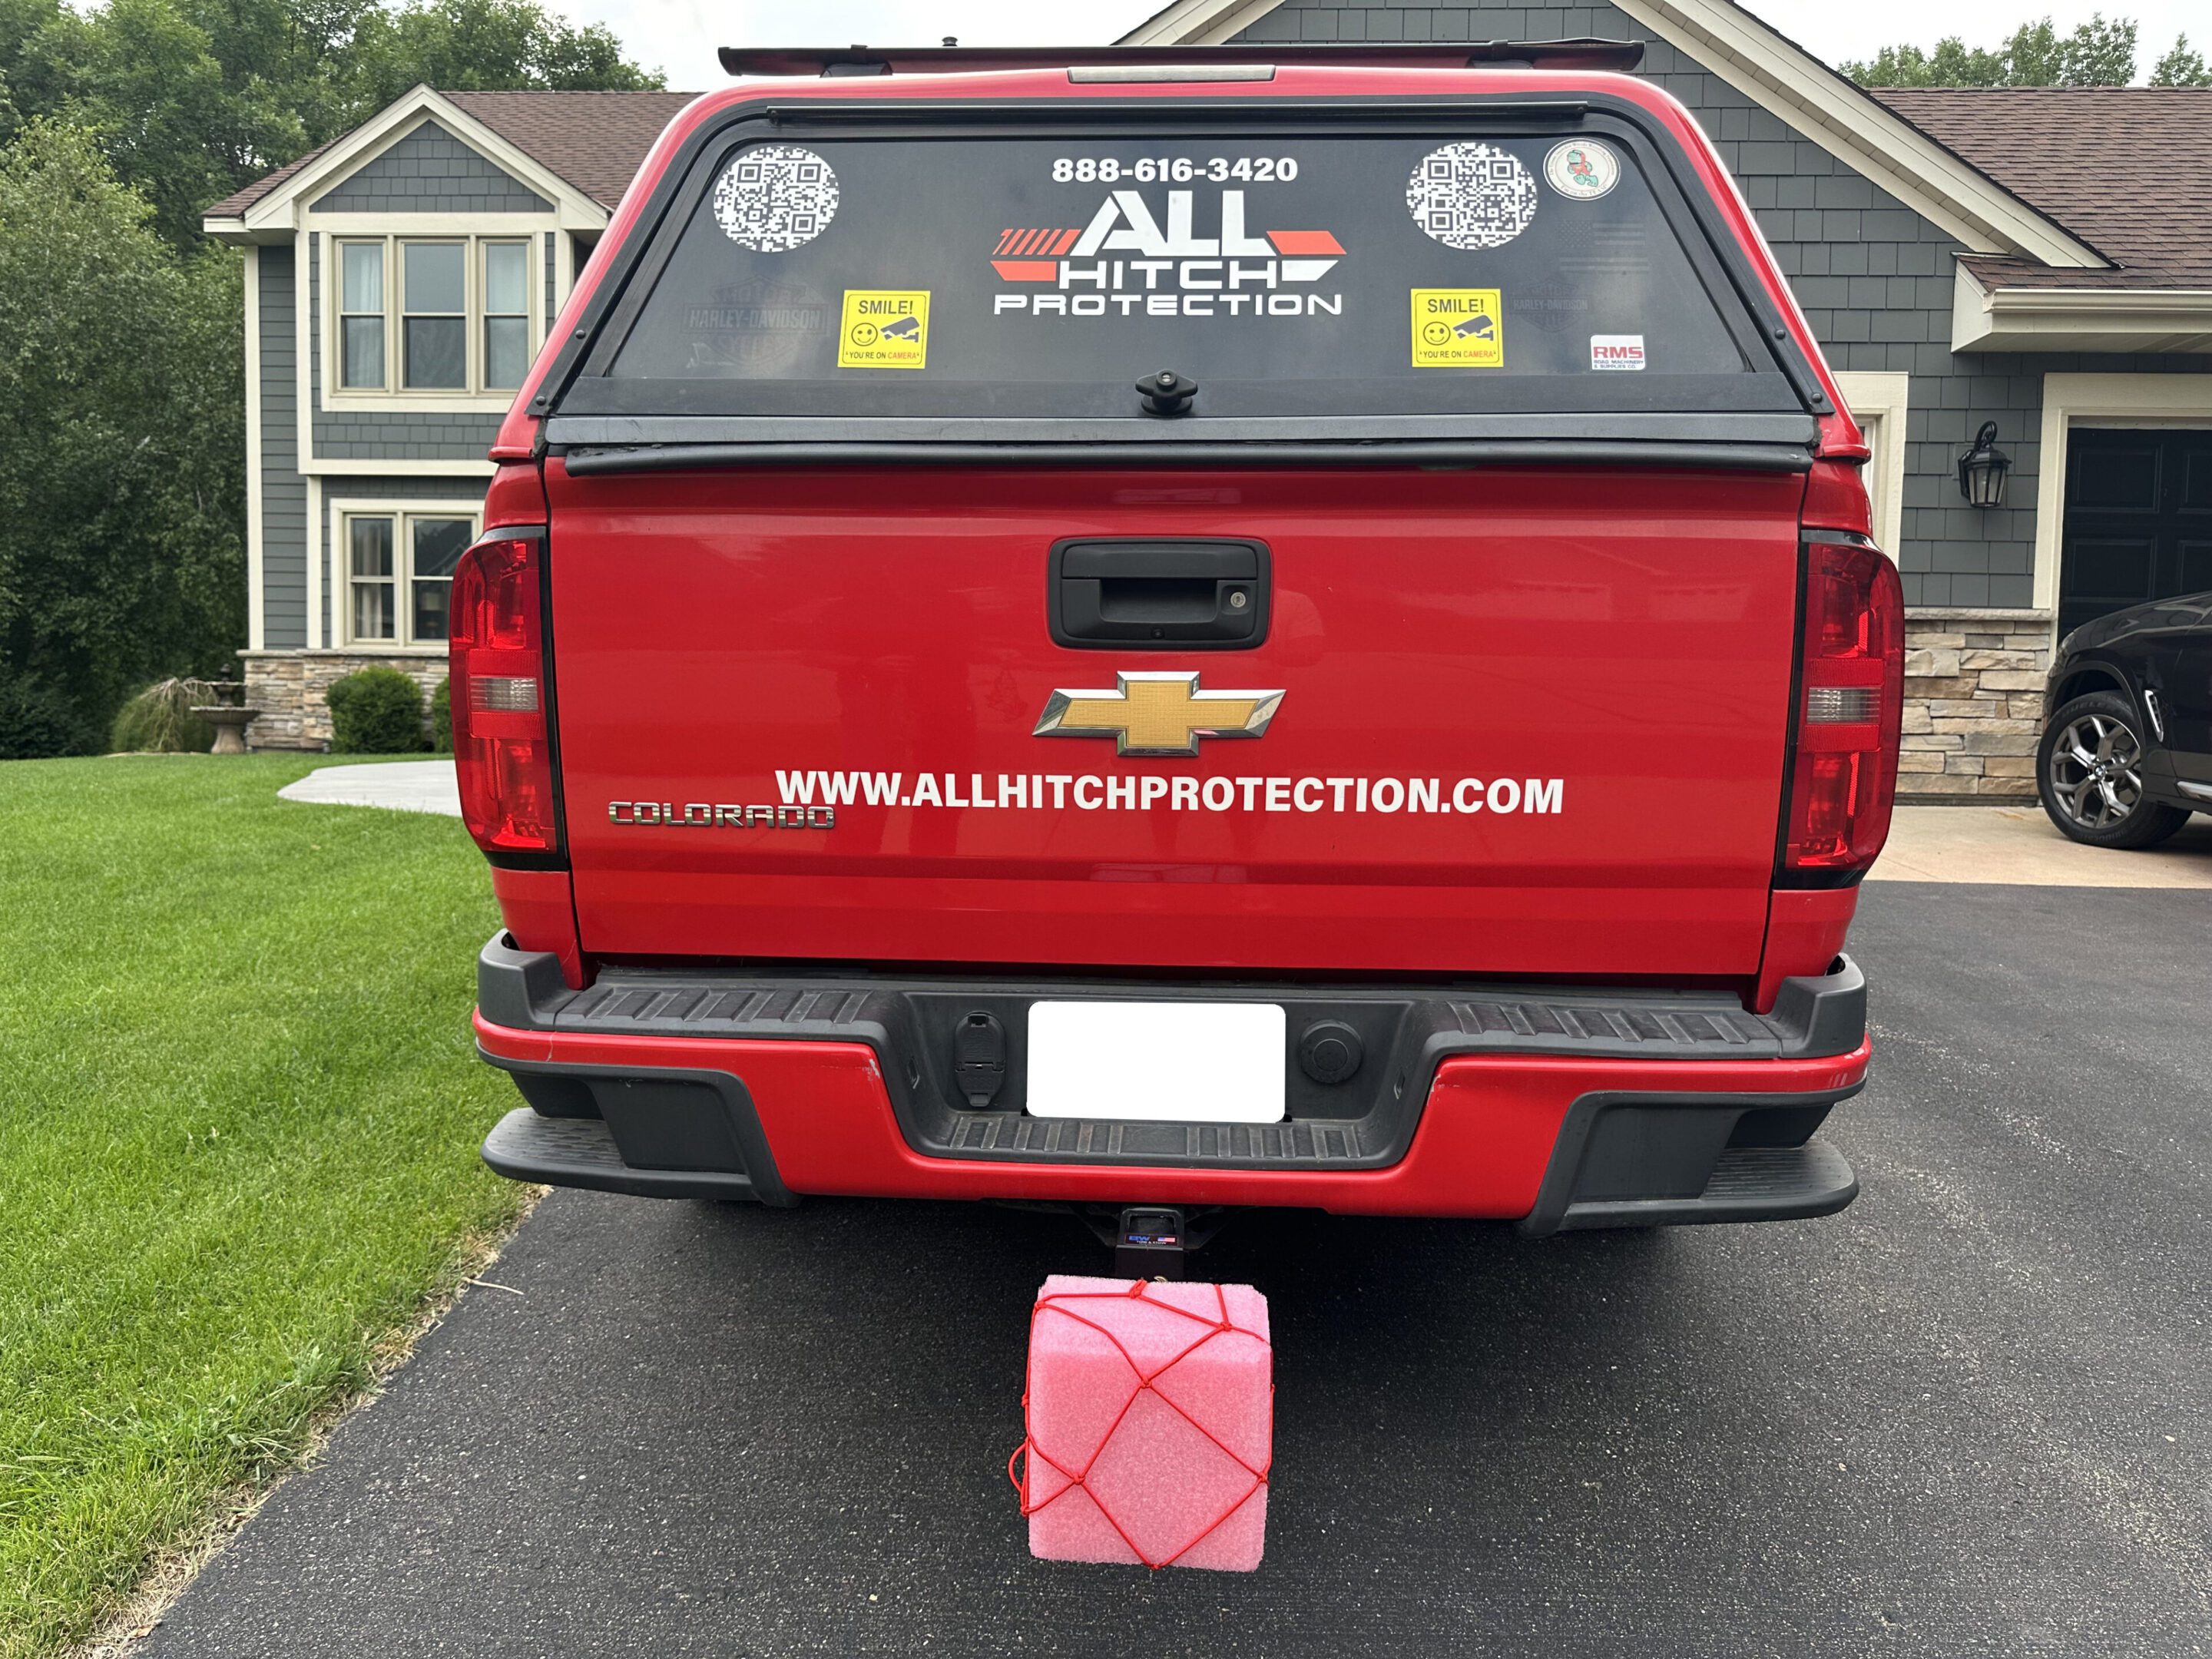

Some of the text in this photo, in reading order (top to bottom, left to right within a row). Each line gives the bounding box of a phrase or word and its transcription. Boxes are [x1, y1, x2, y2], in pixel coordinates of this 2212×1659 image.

[1052, 157, 1298, 182] 888-616-3420
[1068, 190, 1277, 257] ALL
[1058, 260, 1277, 290] HITCH
[858, 300, 913, 314] SMILE!
[993, 294, 1342, 316] PROTECTION
[1427, 298, 1484, 313] SMILE!
[689, 309, 820, 329] HARLEY-DAVIDSON
[1593, 346, 1643, 359] RMS
[775, 770, 1564, 814] WWW.ALLHITCHPROTECTION.COM
[608, 801, 835, 829] COLORADO
